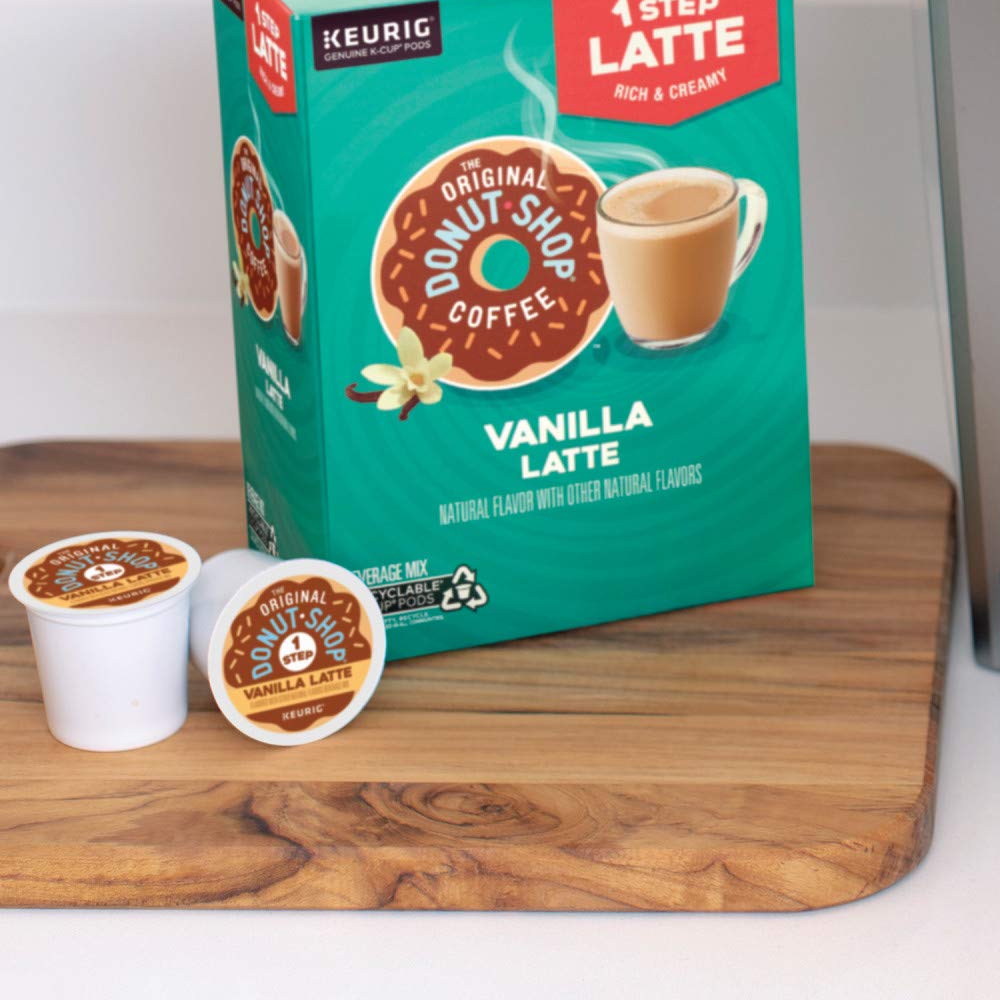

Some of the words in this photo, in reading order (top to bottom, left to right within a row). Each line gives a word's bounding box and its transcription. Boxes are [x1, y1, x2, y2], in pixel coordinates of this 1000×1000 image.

[255, 1, 261, 26] 1
[323, 18, 431, 50] KEURIG
[589, 16, 745, 76] LATTE
[251, 23, 288, 81] LATTE
[324, 48, 368, 62] GENUINE
[404, 40, 432, 51] PODS
[614, 83, 648, 101] RICH
[654, 87, 664, 101] &
[669, 67, 728, 100] CREAMY
[460, 157, 481, 172] THE
[441, 165, 547, 201] ORIGINAL
[424, 190, 502, 298] DONUT
[511, 193, 575, 279] SHOP
[448, 286, 556, 329] COFFEE
[484, 400, 653, 451] VANILLA
[521, 441, 619, 480] LATTE
[439, 498, 490, 525] NATURAL
[492, 490, 534, 517] FLAVOR
[536, 485, 564, 510] WITH
[567, 480, 601, 506] OTHER
[604, 471, 653, 499] NATURAL
[656, 463, 703, 490] FLAVORS
[49, 543, 119, 566] ORIGINAL
[54, 555, 95, 592] DONUT
[104, 551, 157, 569] SHOP
[59, 581, 123, 601] VANILLA
[126, 568, 172, 584] LATTE
[353, 563, 402, 585] VERAGE
[405, 559, 428, 578] MIX
[108, 588, 151, 602] KEURIG
[260, 589, 327, 617] ORIGINAL
[271, 586, 285, 596] THE
[372, 581, 440, 600] YCLABLE
[398, 593, 435, 609] PODS
[251, 606, 299, 680] DONUT
[305, 607, 347, 663] SHOP
[281, 650, 314, 666] STEP
[291, 635, 300, 650] 1
[243, 678, 305, 700] VANILLA
[310, 666, 352, 686] LATTE
[282, 705, 323, 721] KEURIG
